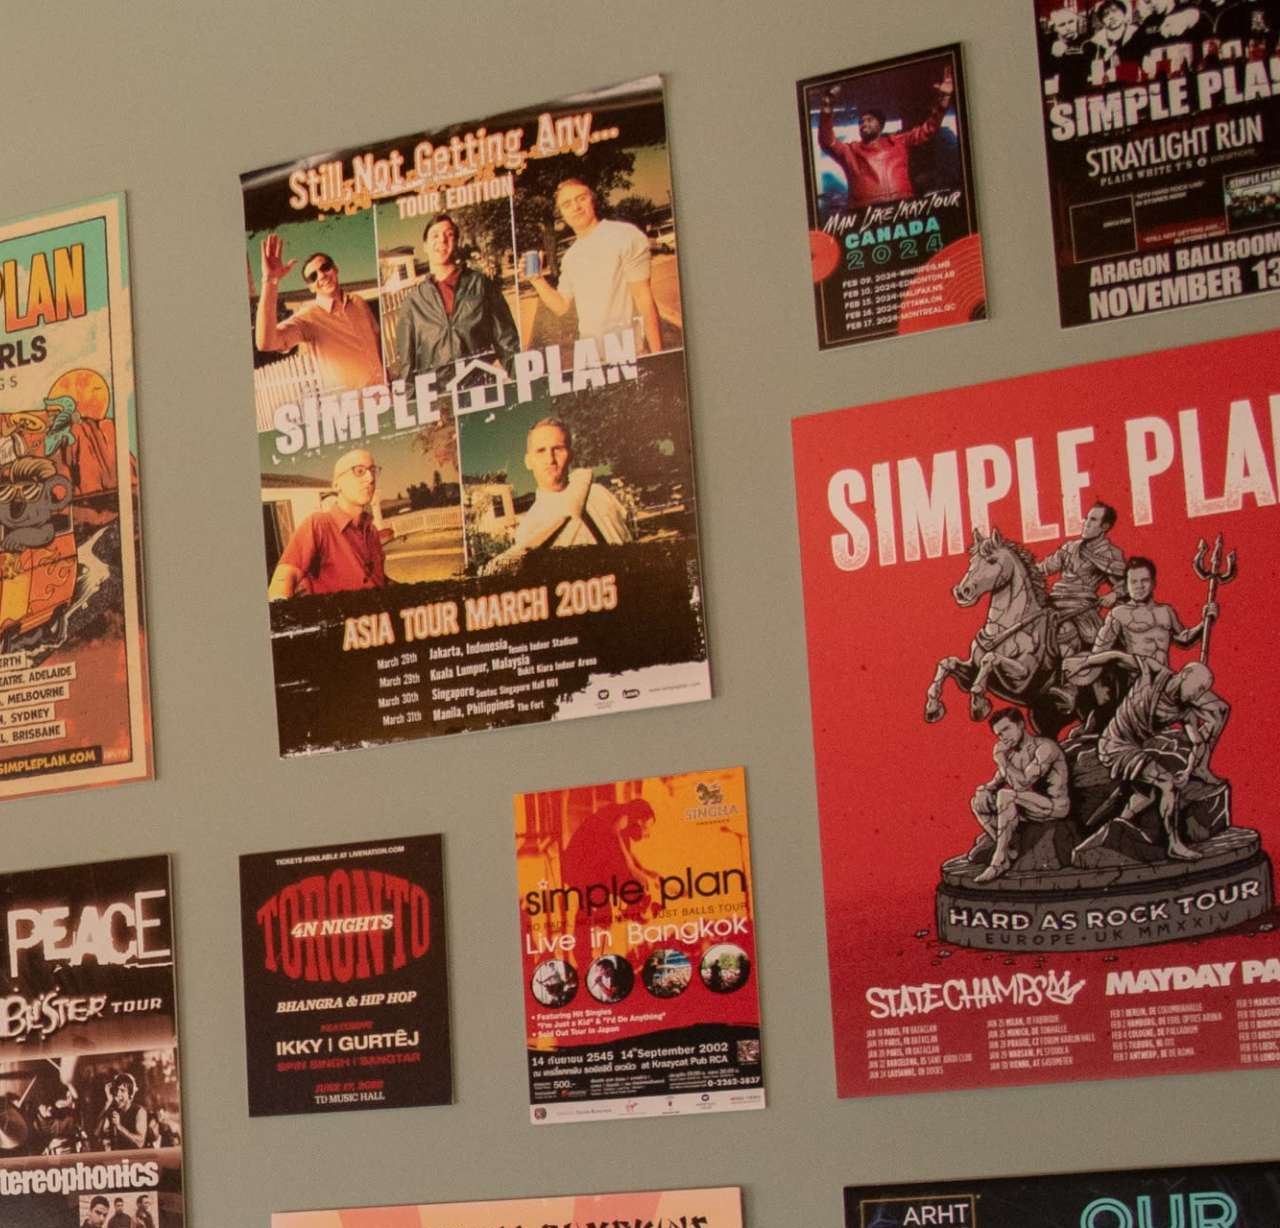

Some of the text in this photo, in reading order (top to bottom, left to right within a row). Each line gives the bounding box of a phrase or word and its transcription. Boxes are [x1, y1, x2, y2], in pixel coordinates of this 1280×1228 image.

[1050, 79, 1190, 141] SIMPLE
[289, 165, 343, 209] Still
[351, 150, 406, 192] Not
[414, 126, 525, 180] Getting
[1086, 115, 1263, 177] STRAYLIGHT RUN
[396, 174, 514, 220] TOUR EDITION
[845, 217, 940, 249] CANADA
[847, 234, 943, 270] 2024
[1089, 253, 1170, 287] ARAGON
[1090, 266, 1242, 320] NOVEMBER
[275, 328, 638, 456] SIMPLE PLAN
[828, 426, 1095, 573] SIMPLE
[344, 575, 617, 651] ASIA TOUR MARCH 2005
[526, 867, 748, 919] simple plan
[950, 880, 1261, 931] HARD AS ROCK TOUR
[7, 889, 173, 978] PEACE
[256, 868, 431, 984] TORONTO
[291, 913, 394, 939] 4N NIGHTS
[526, 914, 748, 956] Live in Bangkok
[111, 997, 162, 1015] TOUR
[276, 1037, 323, 1056] IKKY
